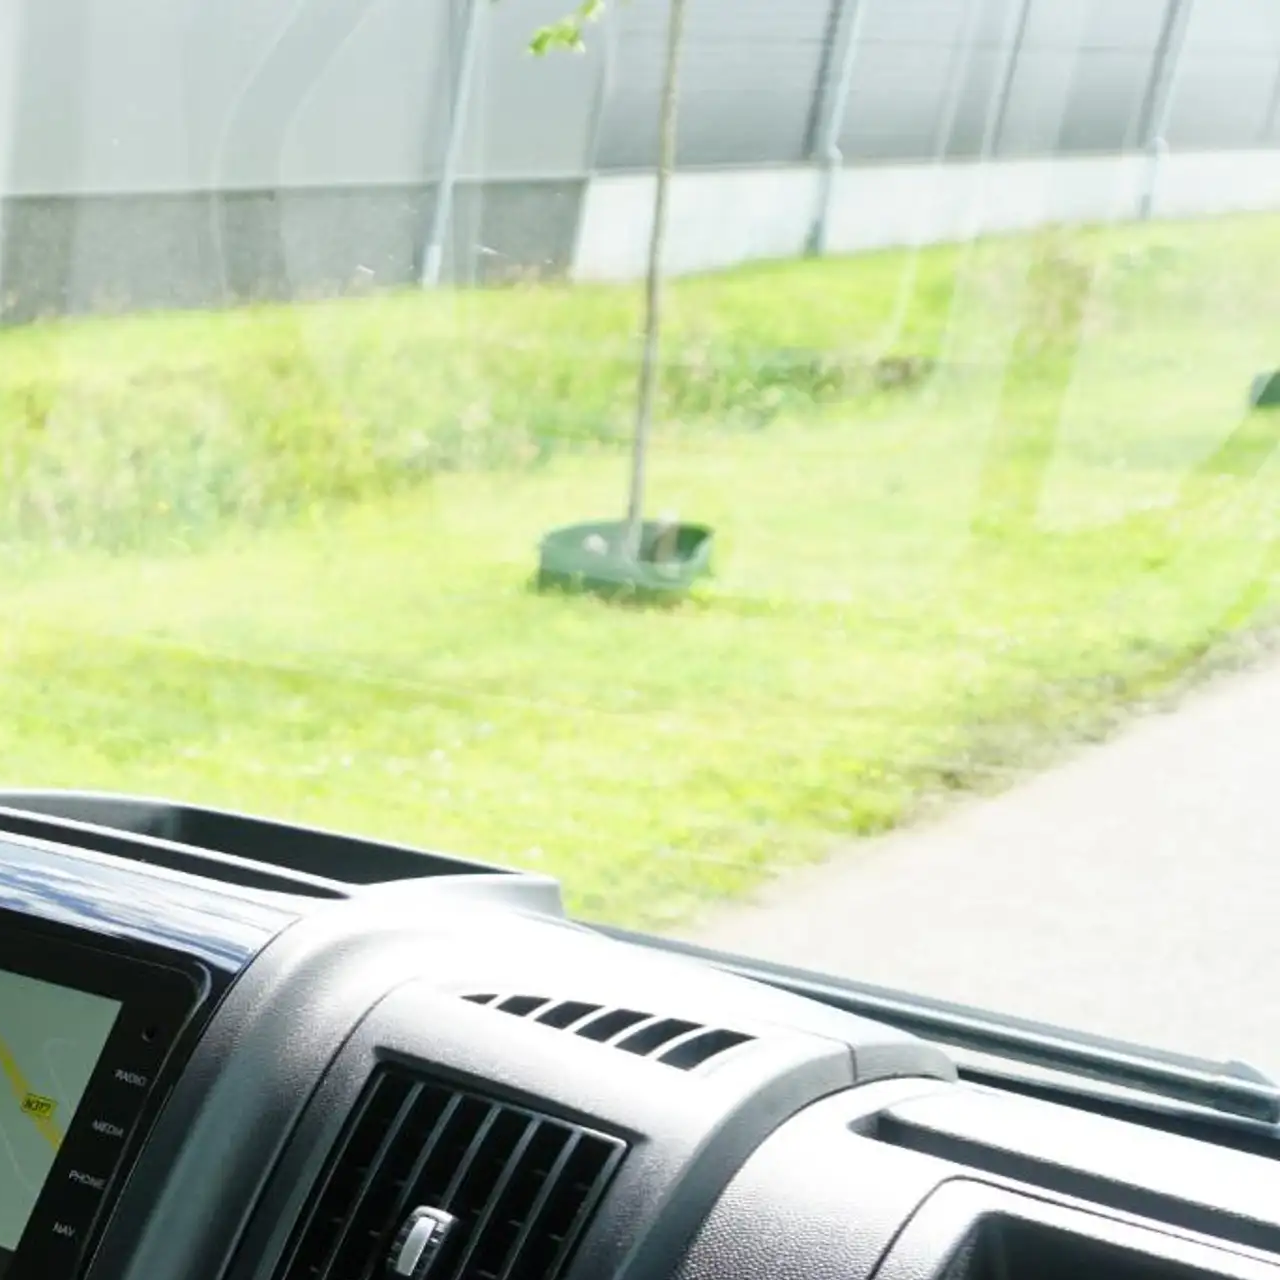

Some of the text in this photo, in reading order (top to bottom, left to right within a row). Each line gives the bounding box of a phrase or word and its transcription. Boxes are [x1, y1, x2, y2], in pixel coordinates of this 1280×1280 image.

[114, 1068, 148, 1087] RADIO
[91, 1118, 125, 1138] MEDIA
[68, 1169, 106, 1190] PHONE
[52, 1221, 76, 1238] NAV
